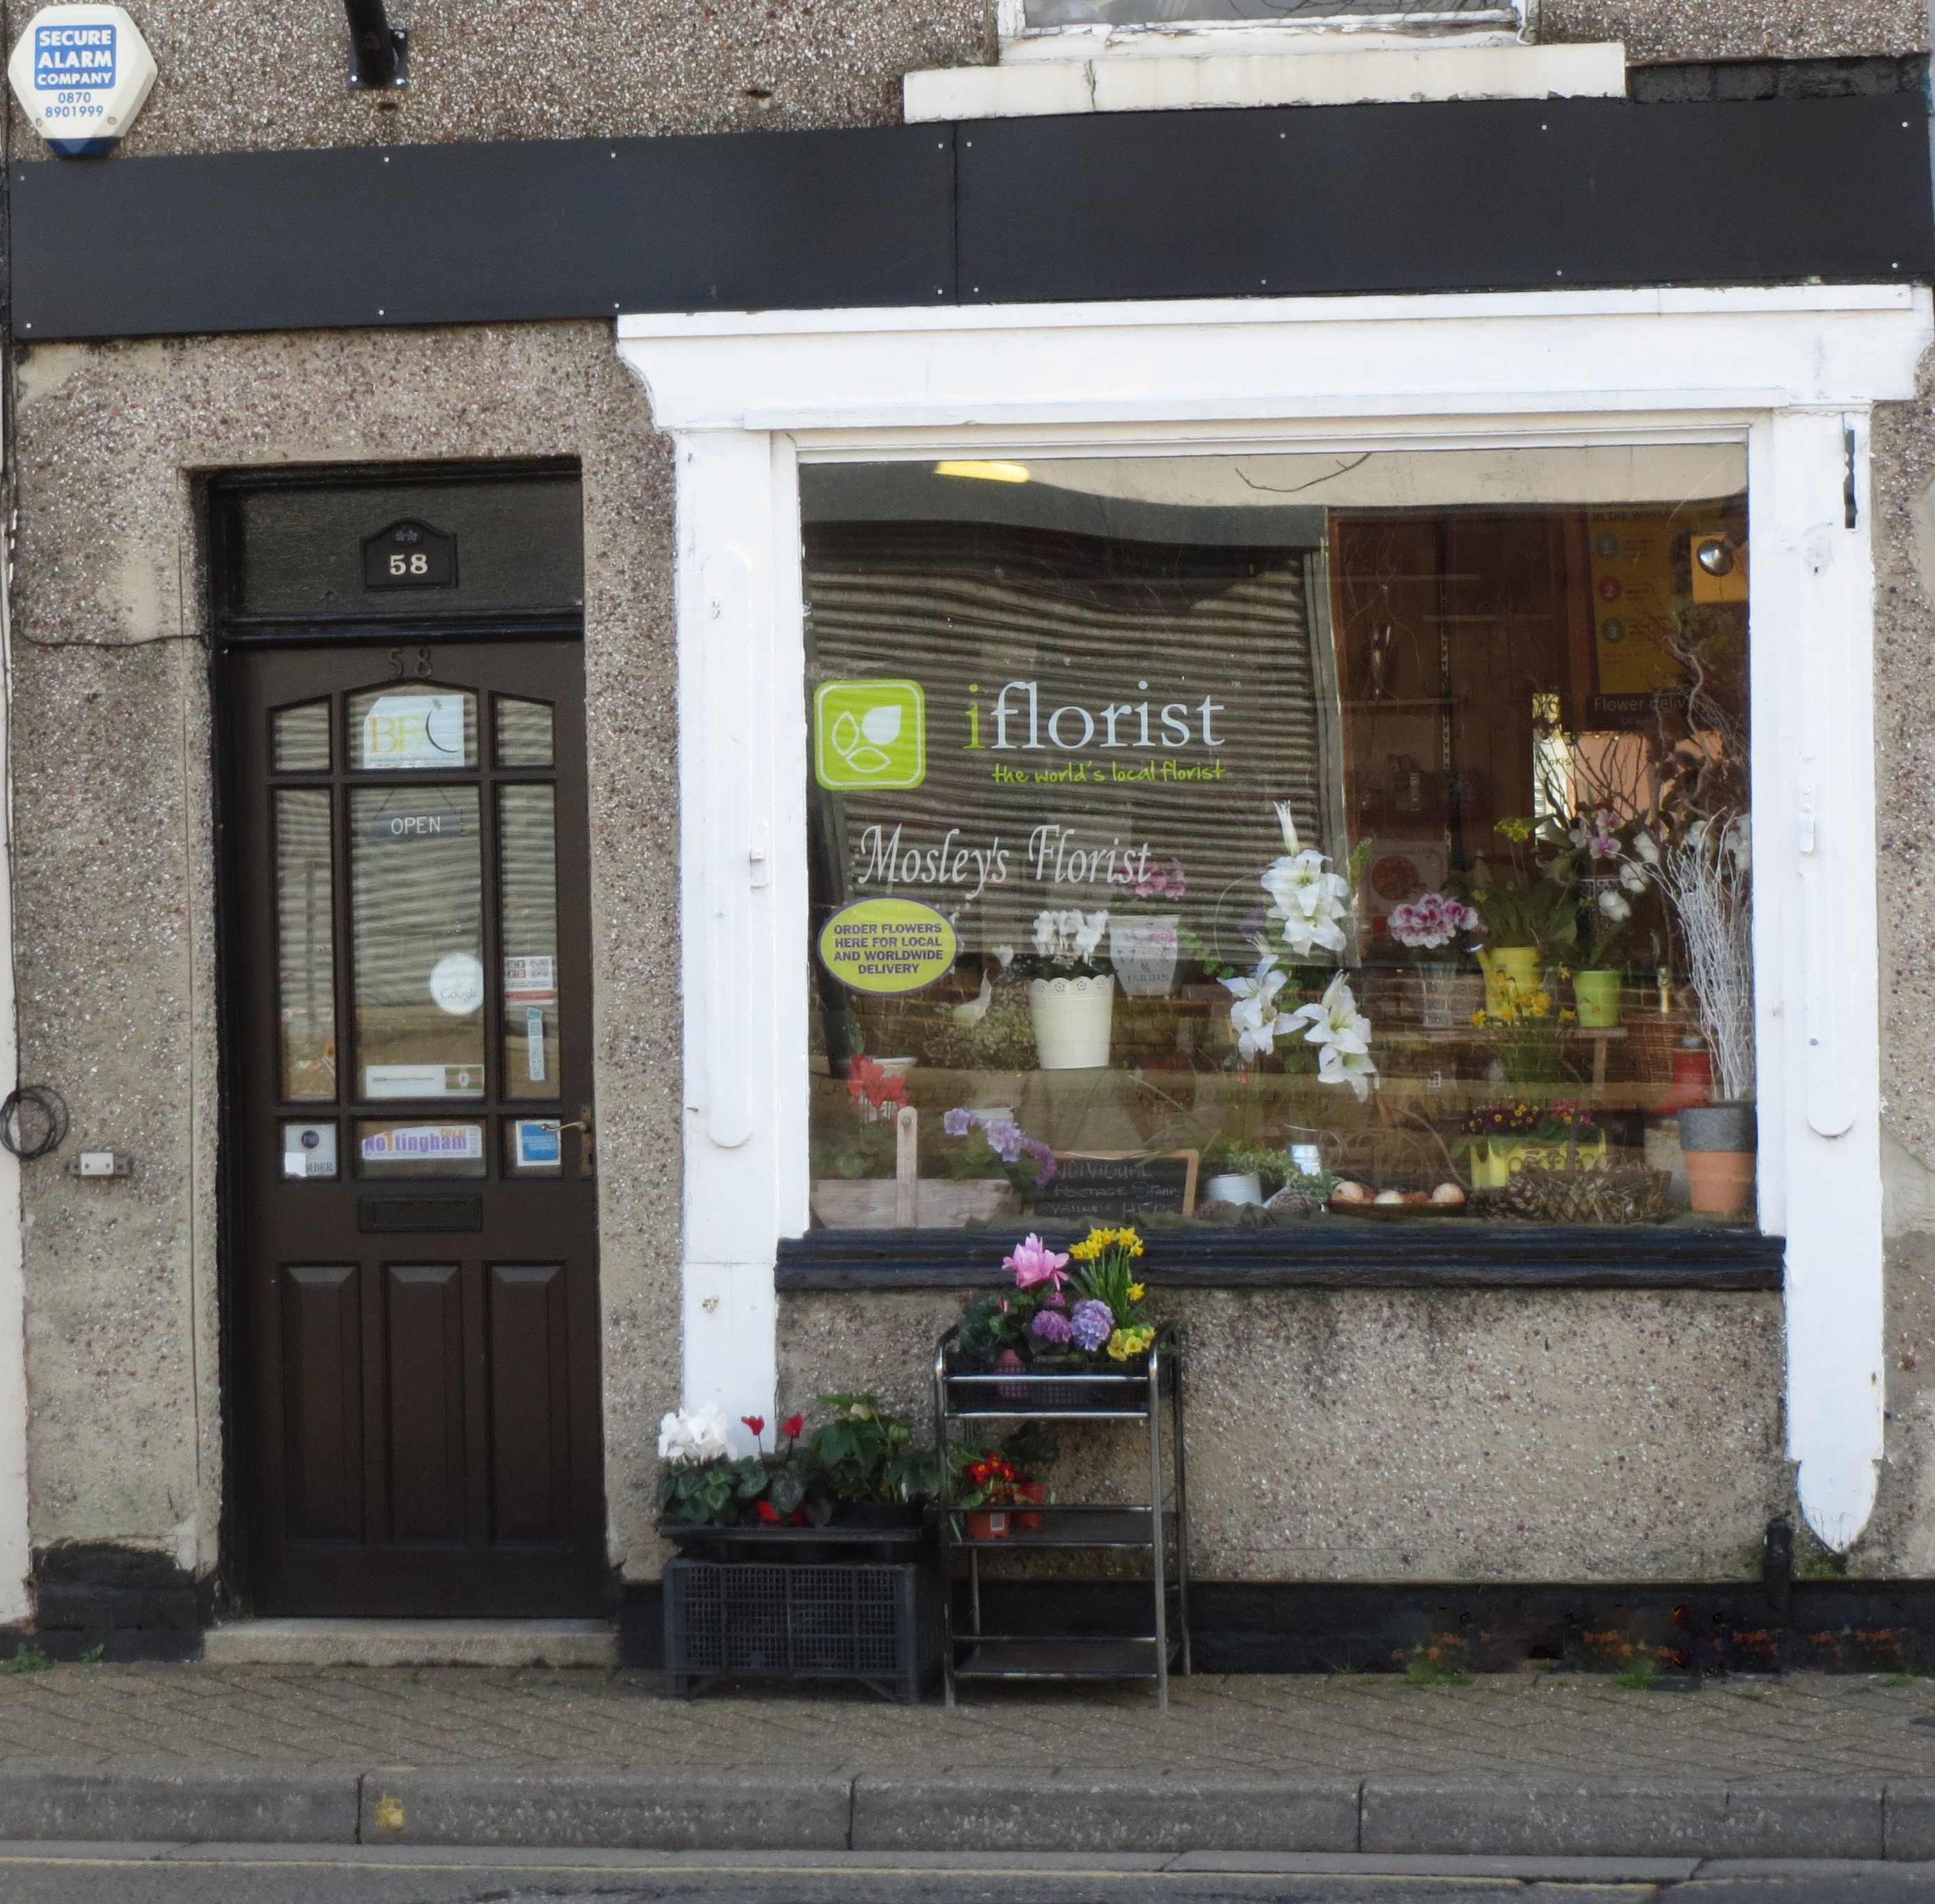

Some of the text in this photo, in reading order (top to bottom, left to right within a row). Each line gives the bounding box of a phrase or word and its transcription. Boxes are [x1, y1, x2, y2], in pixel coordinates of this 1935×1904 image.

[39, 29, 112, 47] SECURE
[38, 50, 113, 68] ALARM
[37, 72, 112, 86] COMPANY
[58, 92, 91, 103] 0870
[45, 105, 104, 118] 8901999
[390, 553, 429, 576] 58
[388, 647, 433, 679] 58
[963, 681, 1226, 749] iflorist
[992, 759, 1226, 783] the world's local florist
[390, 816, 441, 835] OPEN
[858, 823, 1153, 900] Mosley's Florist
[834, 923, 942, 935] ORDER FLOWERS
[835, 937, 942, 948] HERE FOR LOCAL
[834, 950, 943, 961] AND WORLDWIDE
[858, 963, 919, 974] DELIVERY
